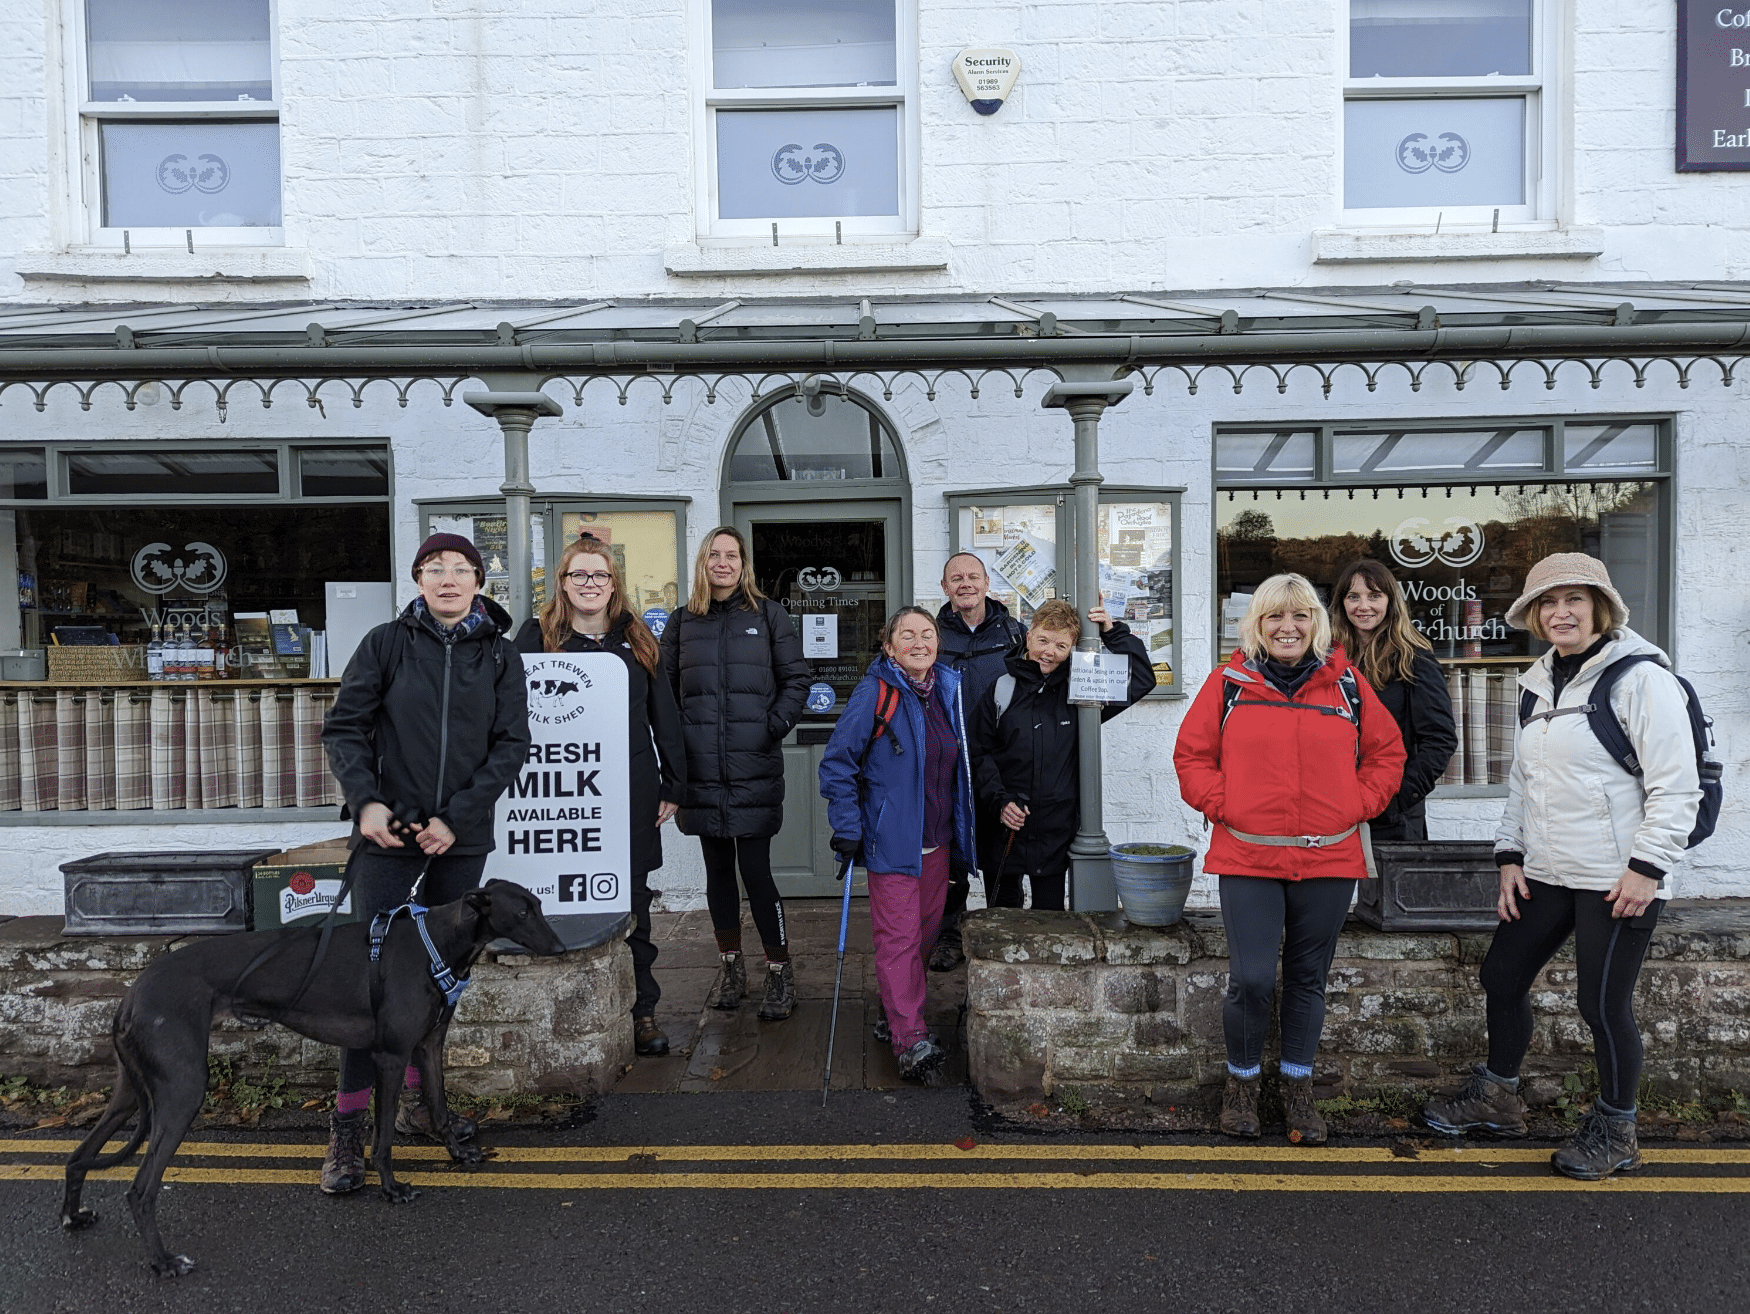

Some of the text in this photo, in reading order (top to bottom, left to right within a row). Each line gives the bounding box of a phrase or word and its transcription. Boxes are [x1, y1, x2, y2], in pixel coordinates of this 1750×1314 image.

[965, 57, 1011, 67] Security
[1397, 578, 1477, 601] Woods
[781, 597, 859, 610] Opening Times
[1430, 604, 1445, 616] of
[140, 605, 221, 627] Woods
[1411, 618, 1507, 640] tchurch
[525, 660, 593, 688] EAT TREWEN
[555, 705, 584, 724] SHED
[525, 742, 601, 764] RESH
[508, 770, 602, 799] MILK
[506, 807, 602, 822] AVAILABLE
[508, 828, 602, 854] HERE
[537, 884, 554, 894] us!
[285, 891, 340, 914] Pilsner Urque
